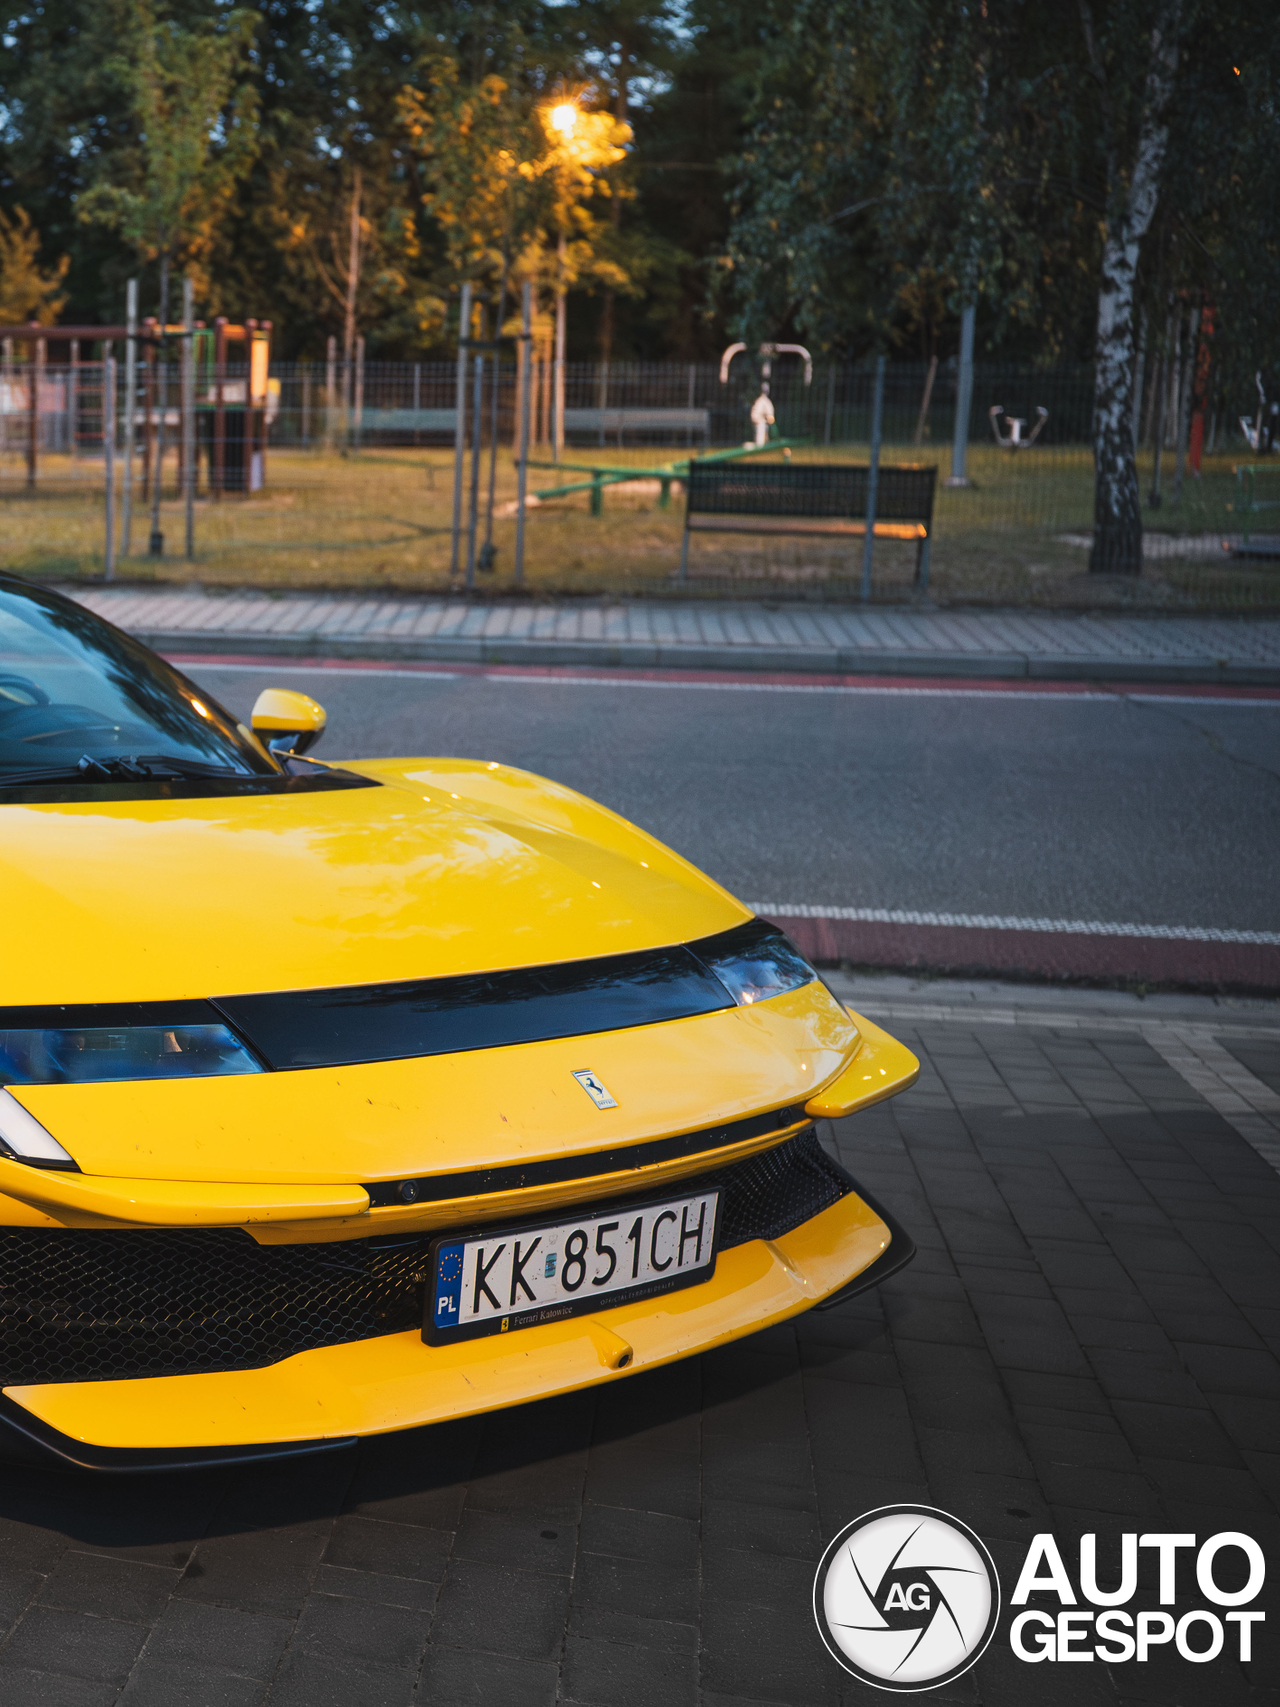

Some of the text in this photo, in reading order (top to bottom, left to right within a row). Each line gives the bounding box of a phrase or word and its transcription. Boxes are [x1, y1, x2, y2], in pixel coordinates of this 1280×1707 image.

[472, 1201, 707, 1314] KK 851CH
[437, 1295, 457, 1315] PL
[513, 1306, 573, 1326] Ferrari Katowice
